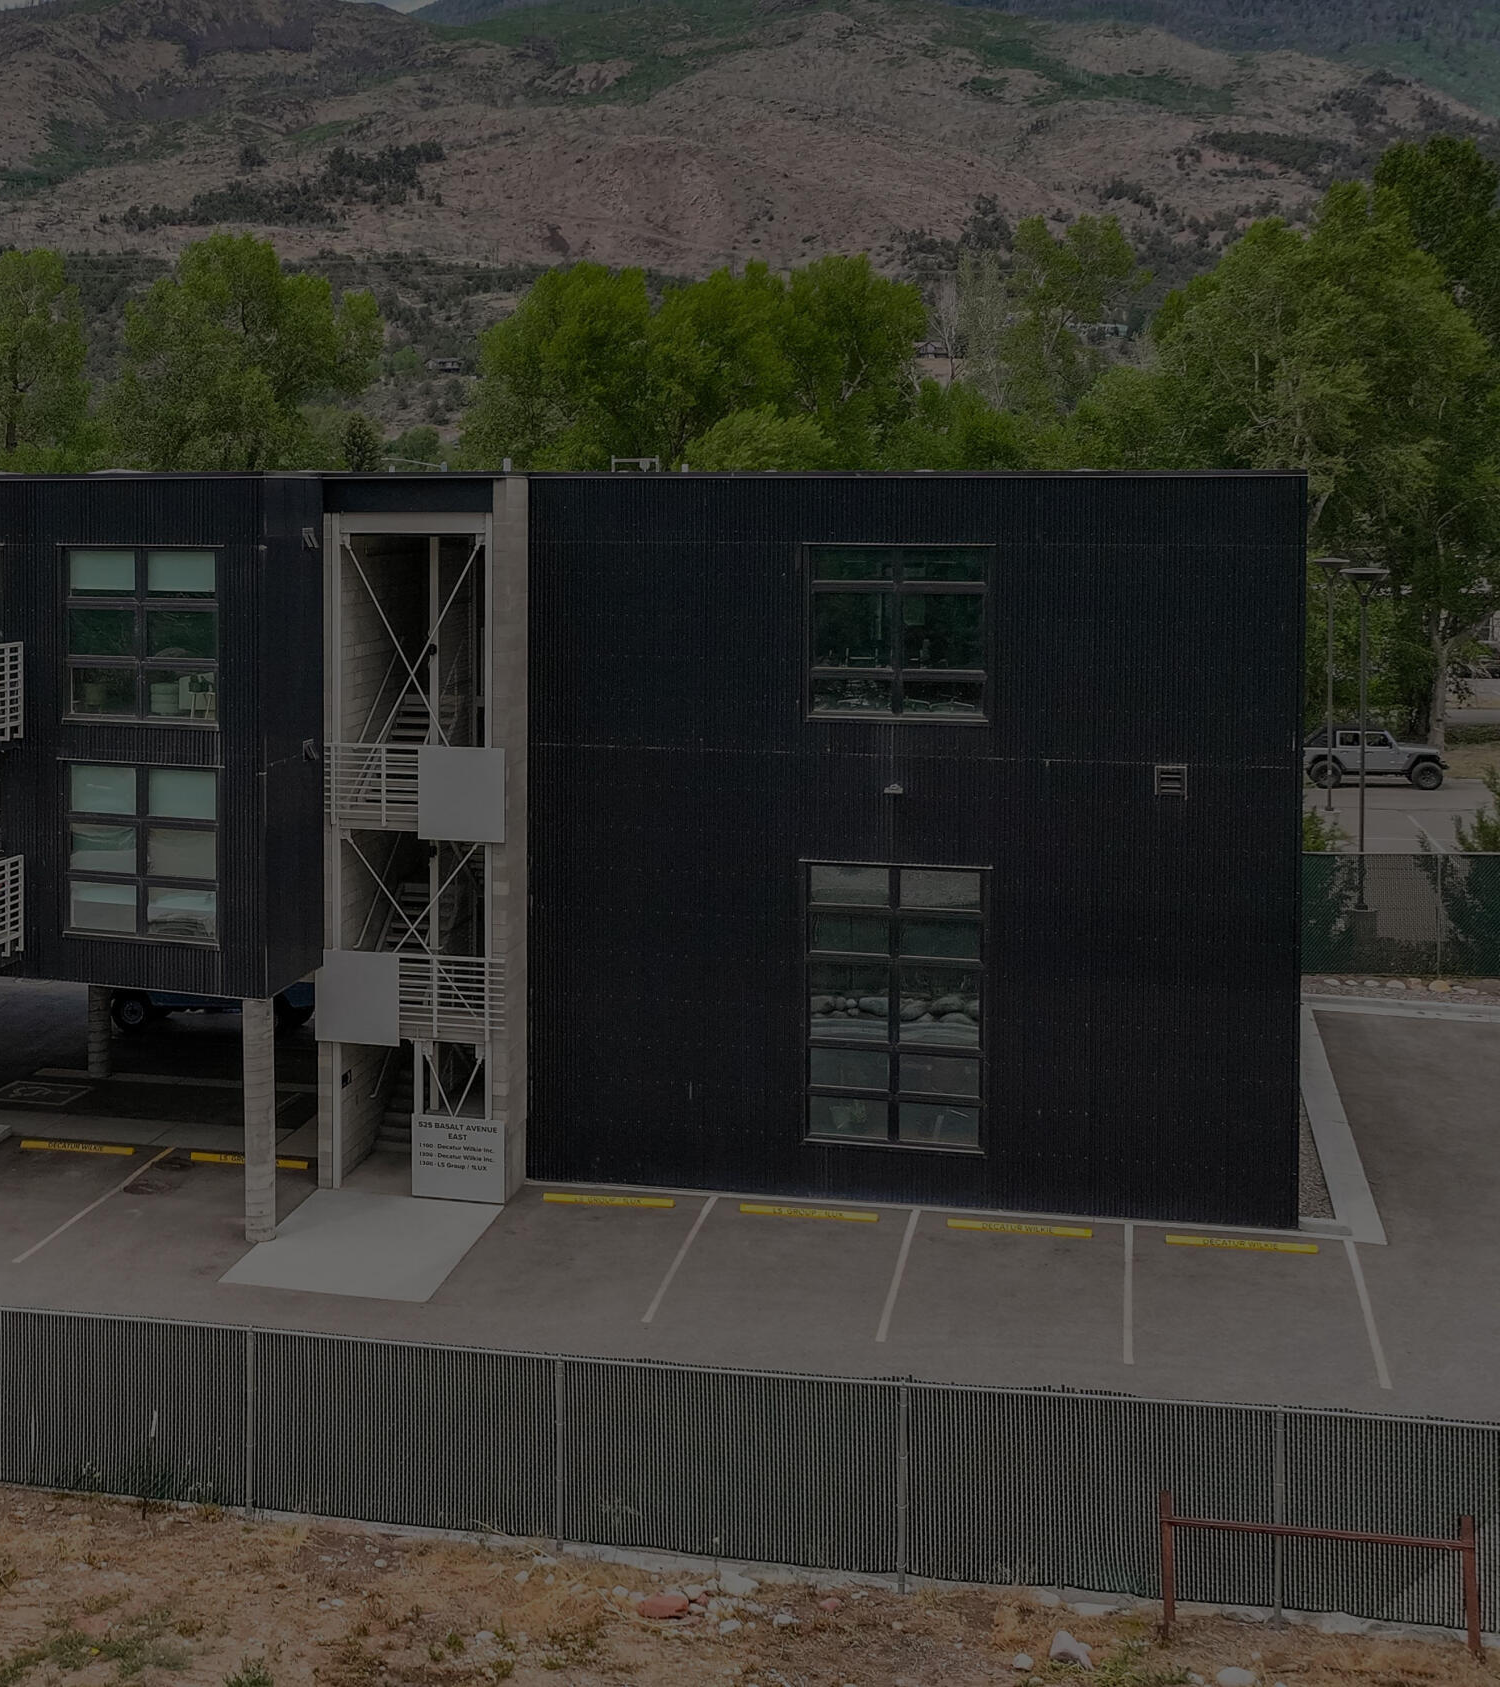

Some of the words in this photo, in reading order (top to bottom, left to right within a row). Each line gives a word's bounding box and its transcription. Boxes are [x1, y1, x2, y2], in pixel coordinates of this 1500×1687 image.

[418, 1121, 433, 1129] 525
[434, 1122, 464, 1131] BASALT
[466, 1125, 498, 1134] AVENUE
[448, 1133, 467, 1141] EAST
[981, 1222, 1024, 1232] DECATUR
[1025, 1224, 1053, 1234] WILKIE
[1202, 1238, 1246, 1247] DECATUR
[1247, 1241, 1280, 1250] WILKIE
